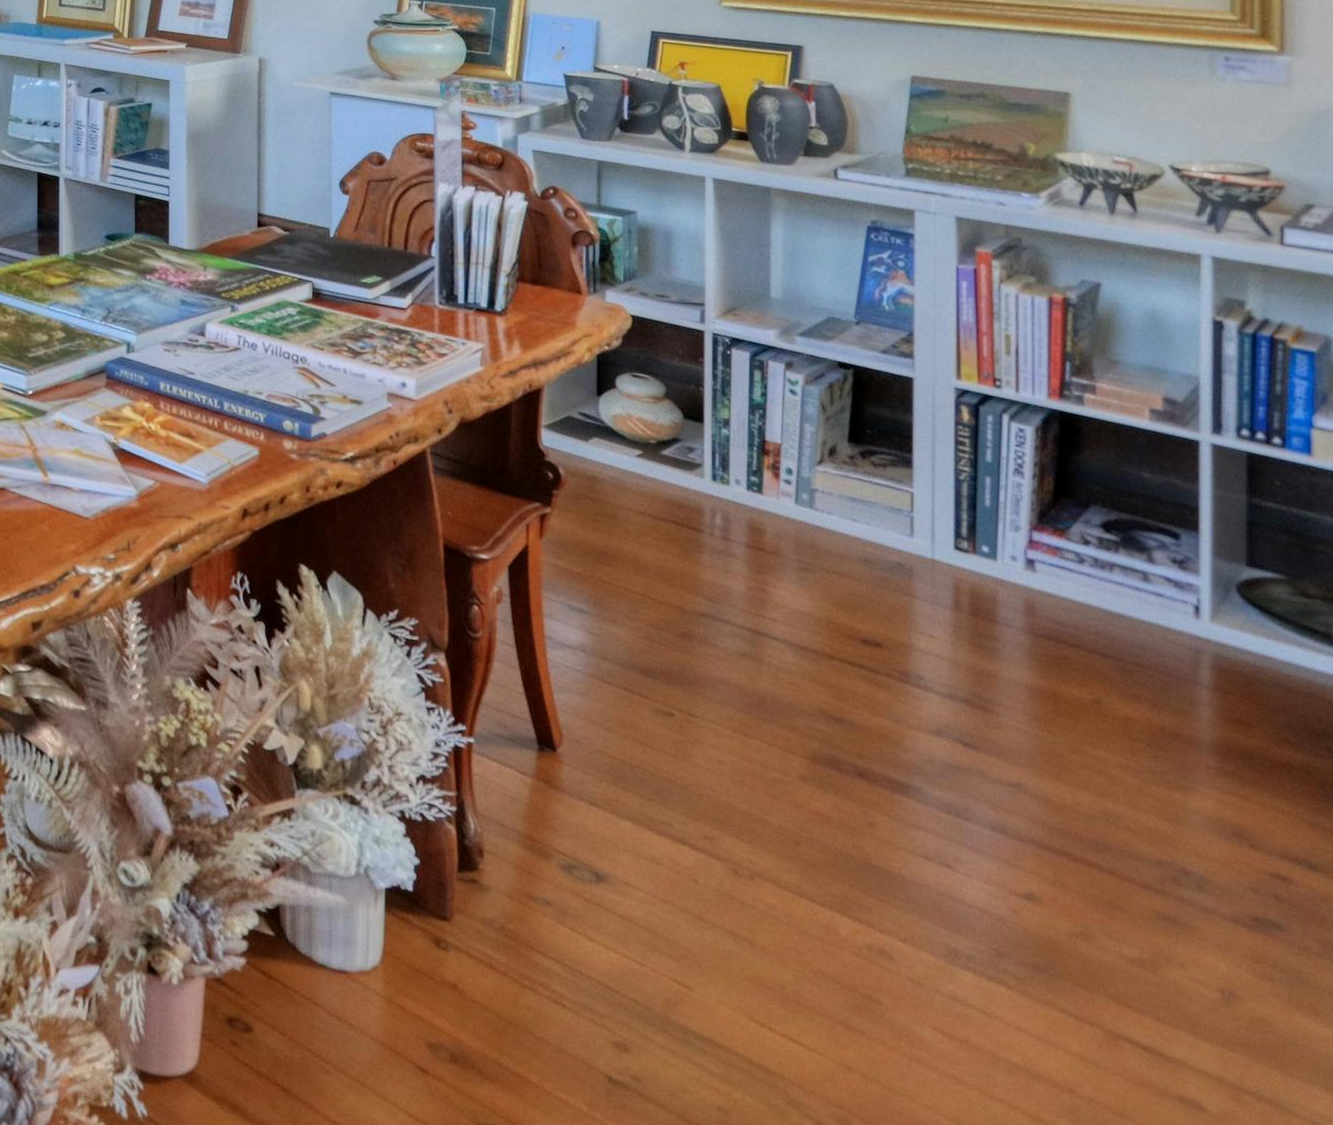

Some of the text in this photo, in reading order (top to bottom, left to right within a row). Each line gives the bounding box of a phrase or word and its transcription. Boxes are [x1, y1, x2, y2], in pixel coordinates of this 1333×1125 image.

[236, 334, 258, 351] The
[262, 341, 311, 366] Village.
[159, 381, 267, 423] ELEMENTAL ENERGY
[1015, 427, 1027, 449] KEN
[1013, 451, 1025, 479] DONE
